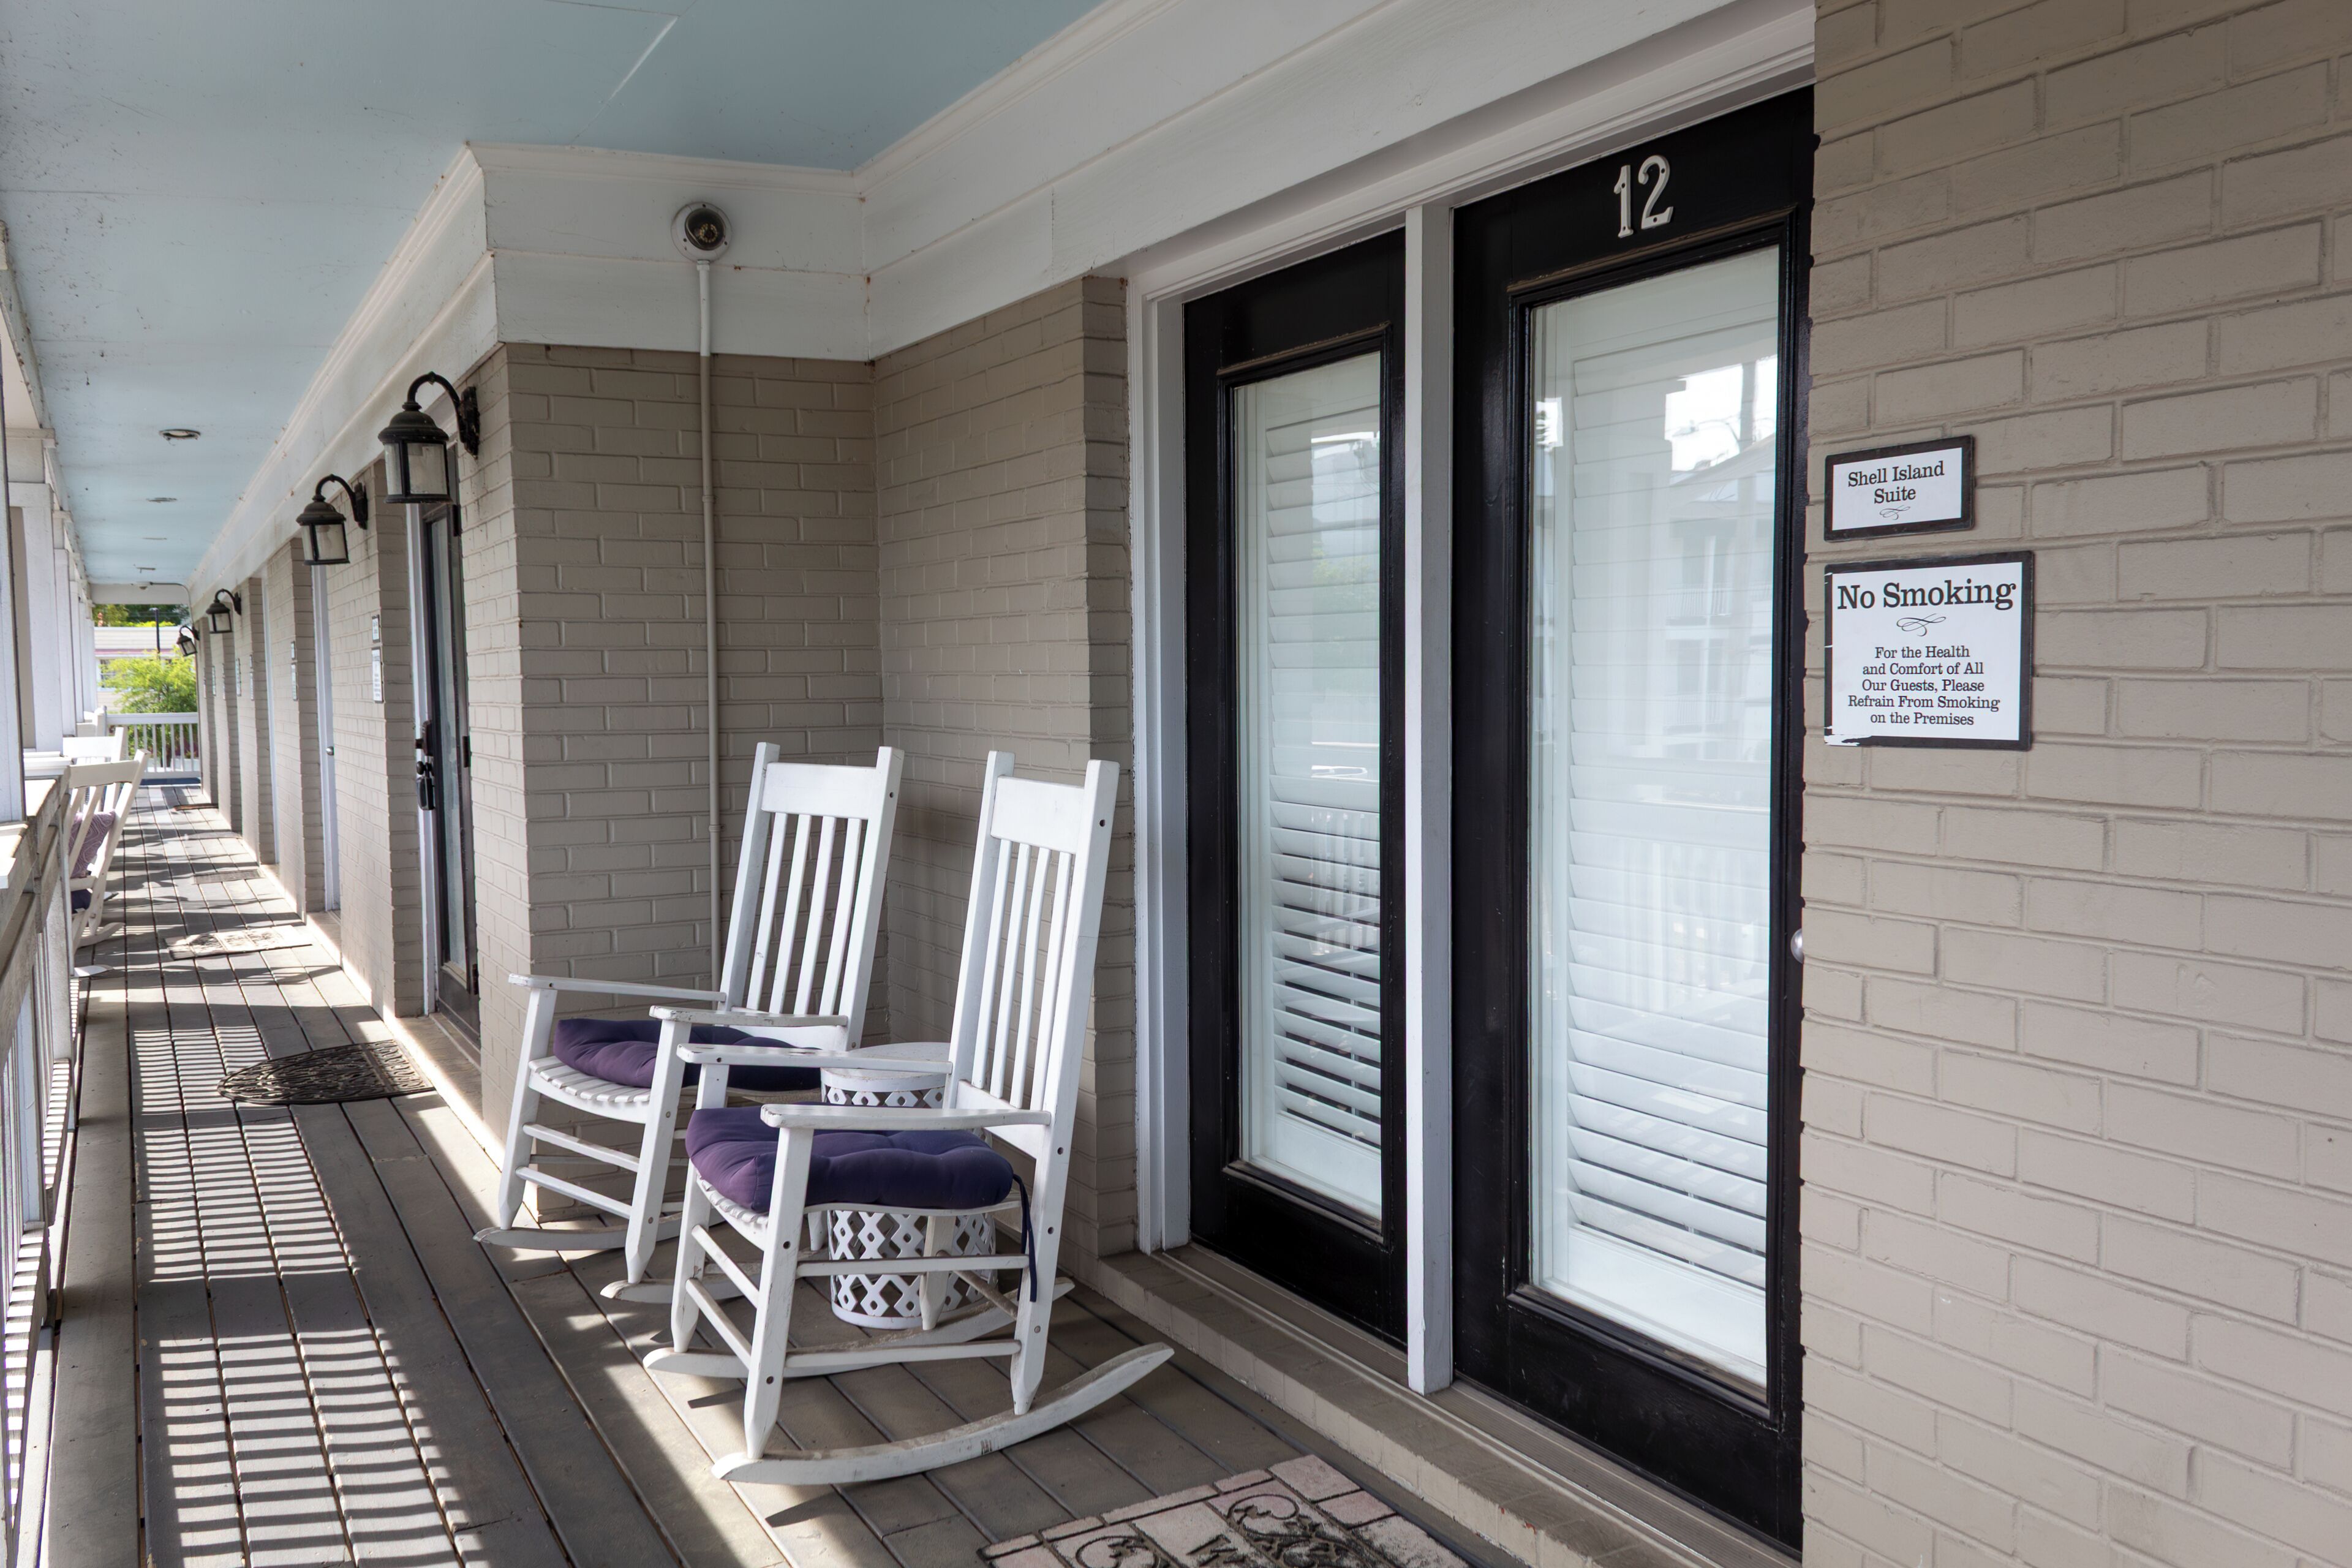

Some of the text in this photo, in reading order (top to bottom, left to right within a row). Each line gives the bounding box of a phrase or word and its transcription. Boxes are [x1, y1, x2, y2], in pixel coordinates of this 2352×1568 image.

[1613, 155, 1673, 238] 12
[1847, 461, 1945, 488] Shell Island
[1873, 486, 1917, 504] Suite
[1837, 578, 2017, 611] No Smoking
[1875, 645, 1970, 659] For the Health
[1863, 662, 1984, 675] and Comfort of All
[1862, 679, 1985, 693] Our Guests, Please
[1848, 695, 2000, 712] Refrain From Smoking
[1870, 712, 1974, 726] on the Premises
